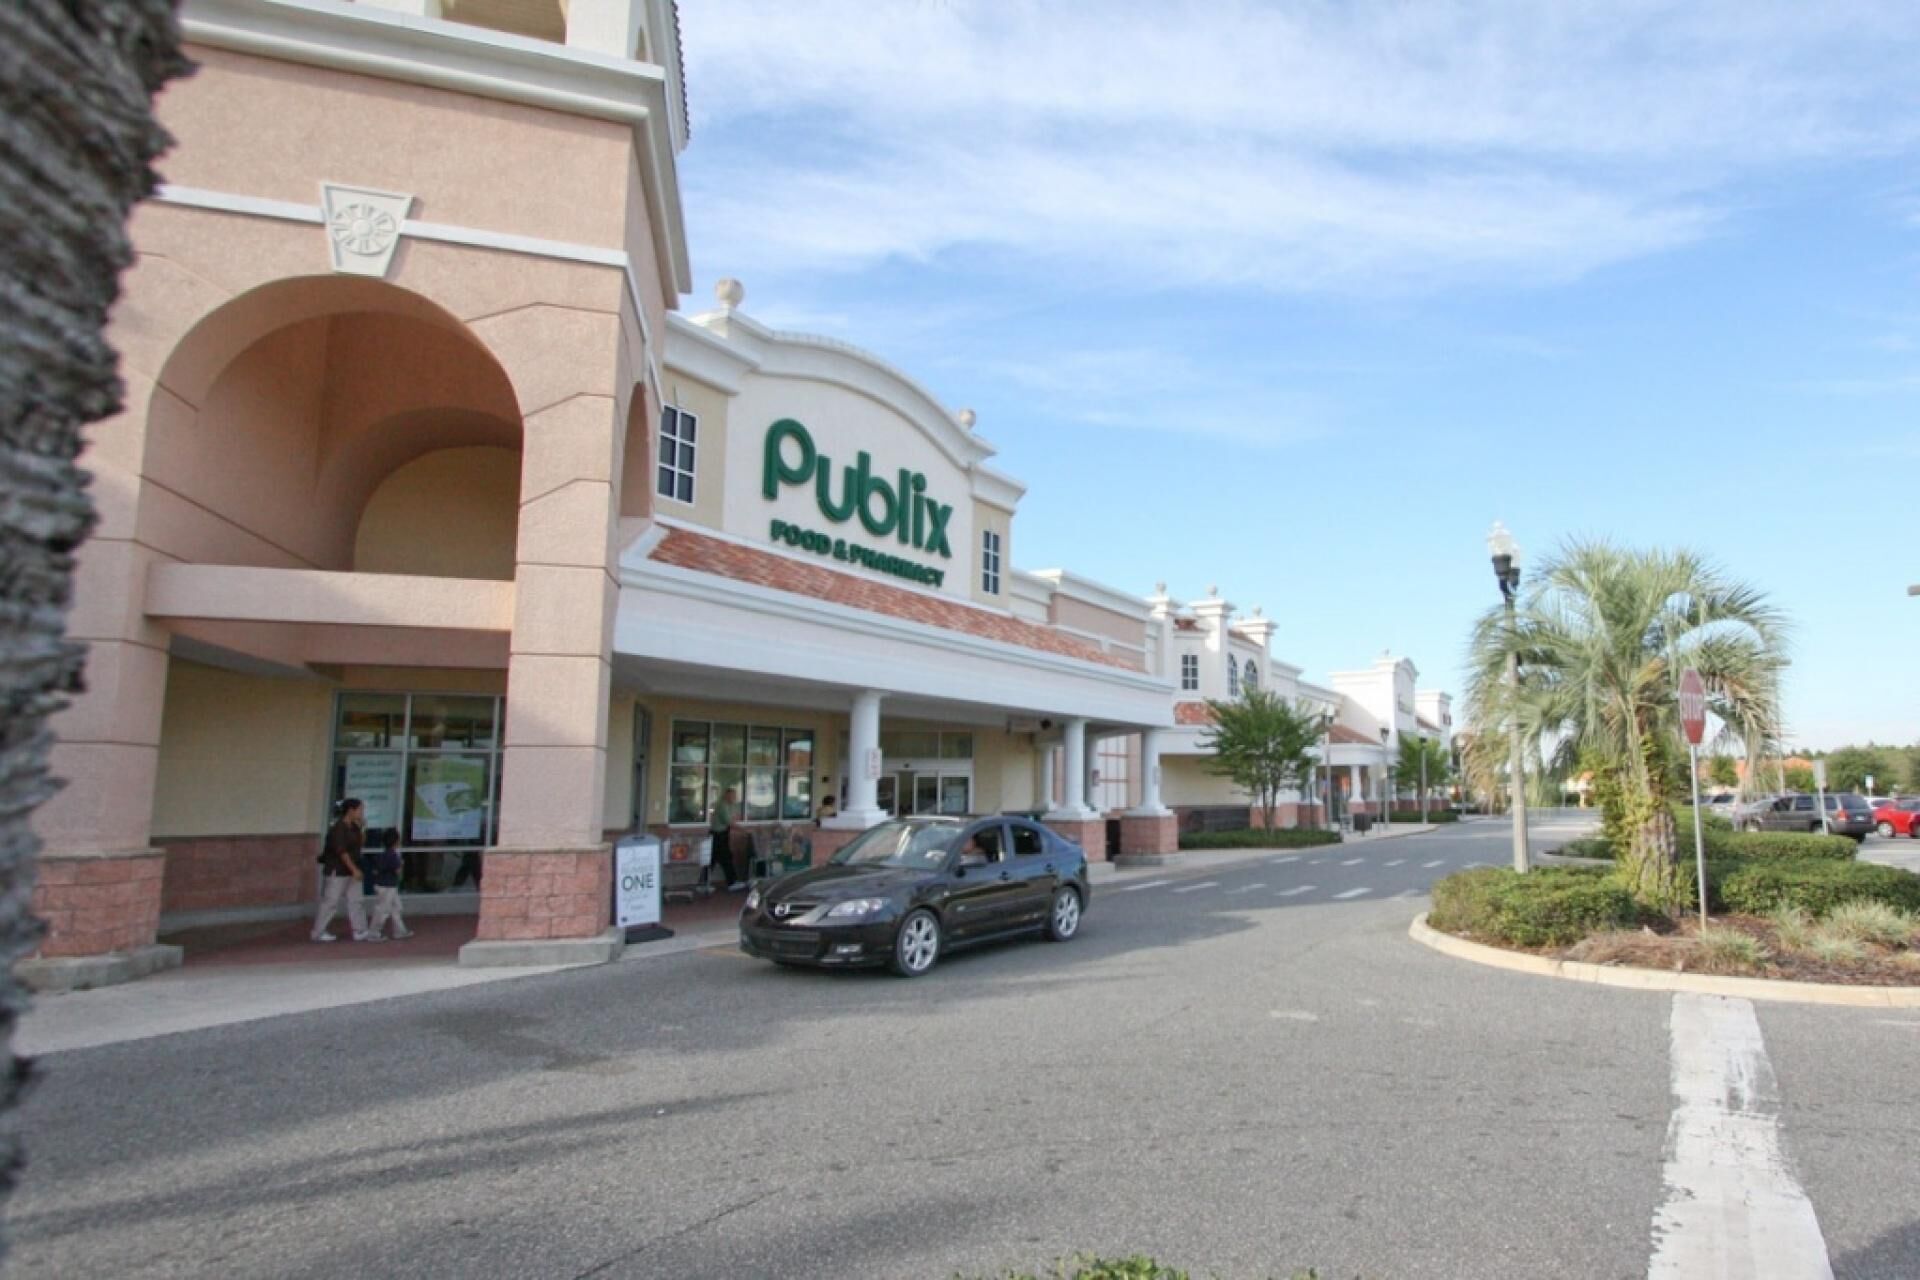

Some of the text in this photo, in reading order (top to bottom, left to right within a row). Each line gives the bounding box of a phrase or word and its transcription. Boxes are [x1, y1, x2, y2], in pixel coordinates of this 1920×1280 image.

[763, 418, 953, 559] Publix
[770, 518, 945, 588] FOOD & PHARMACY
[621, 872, 654, 891] ONE
